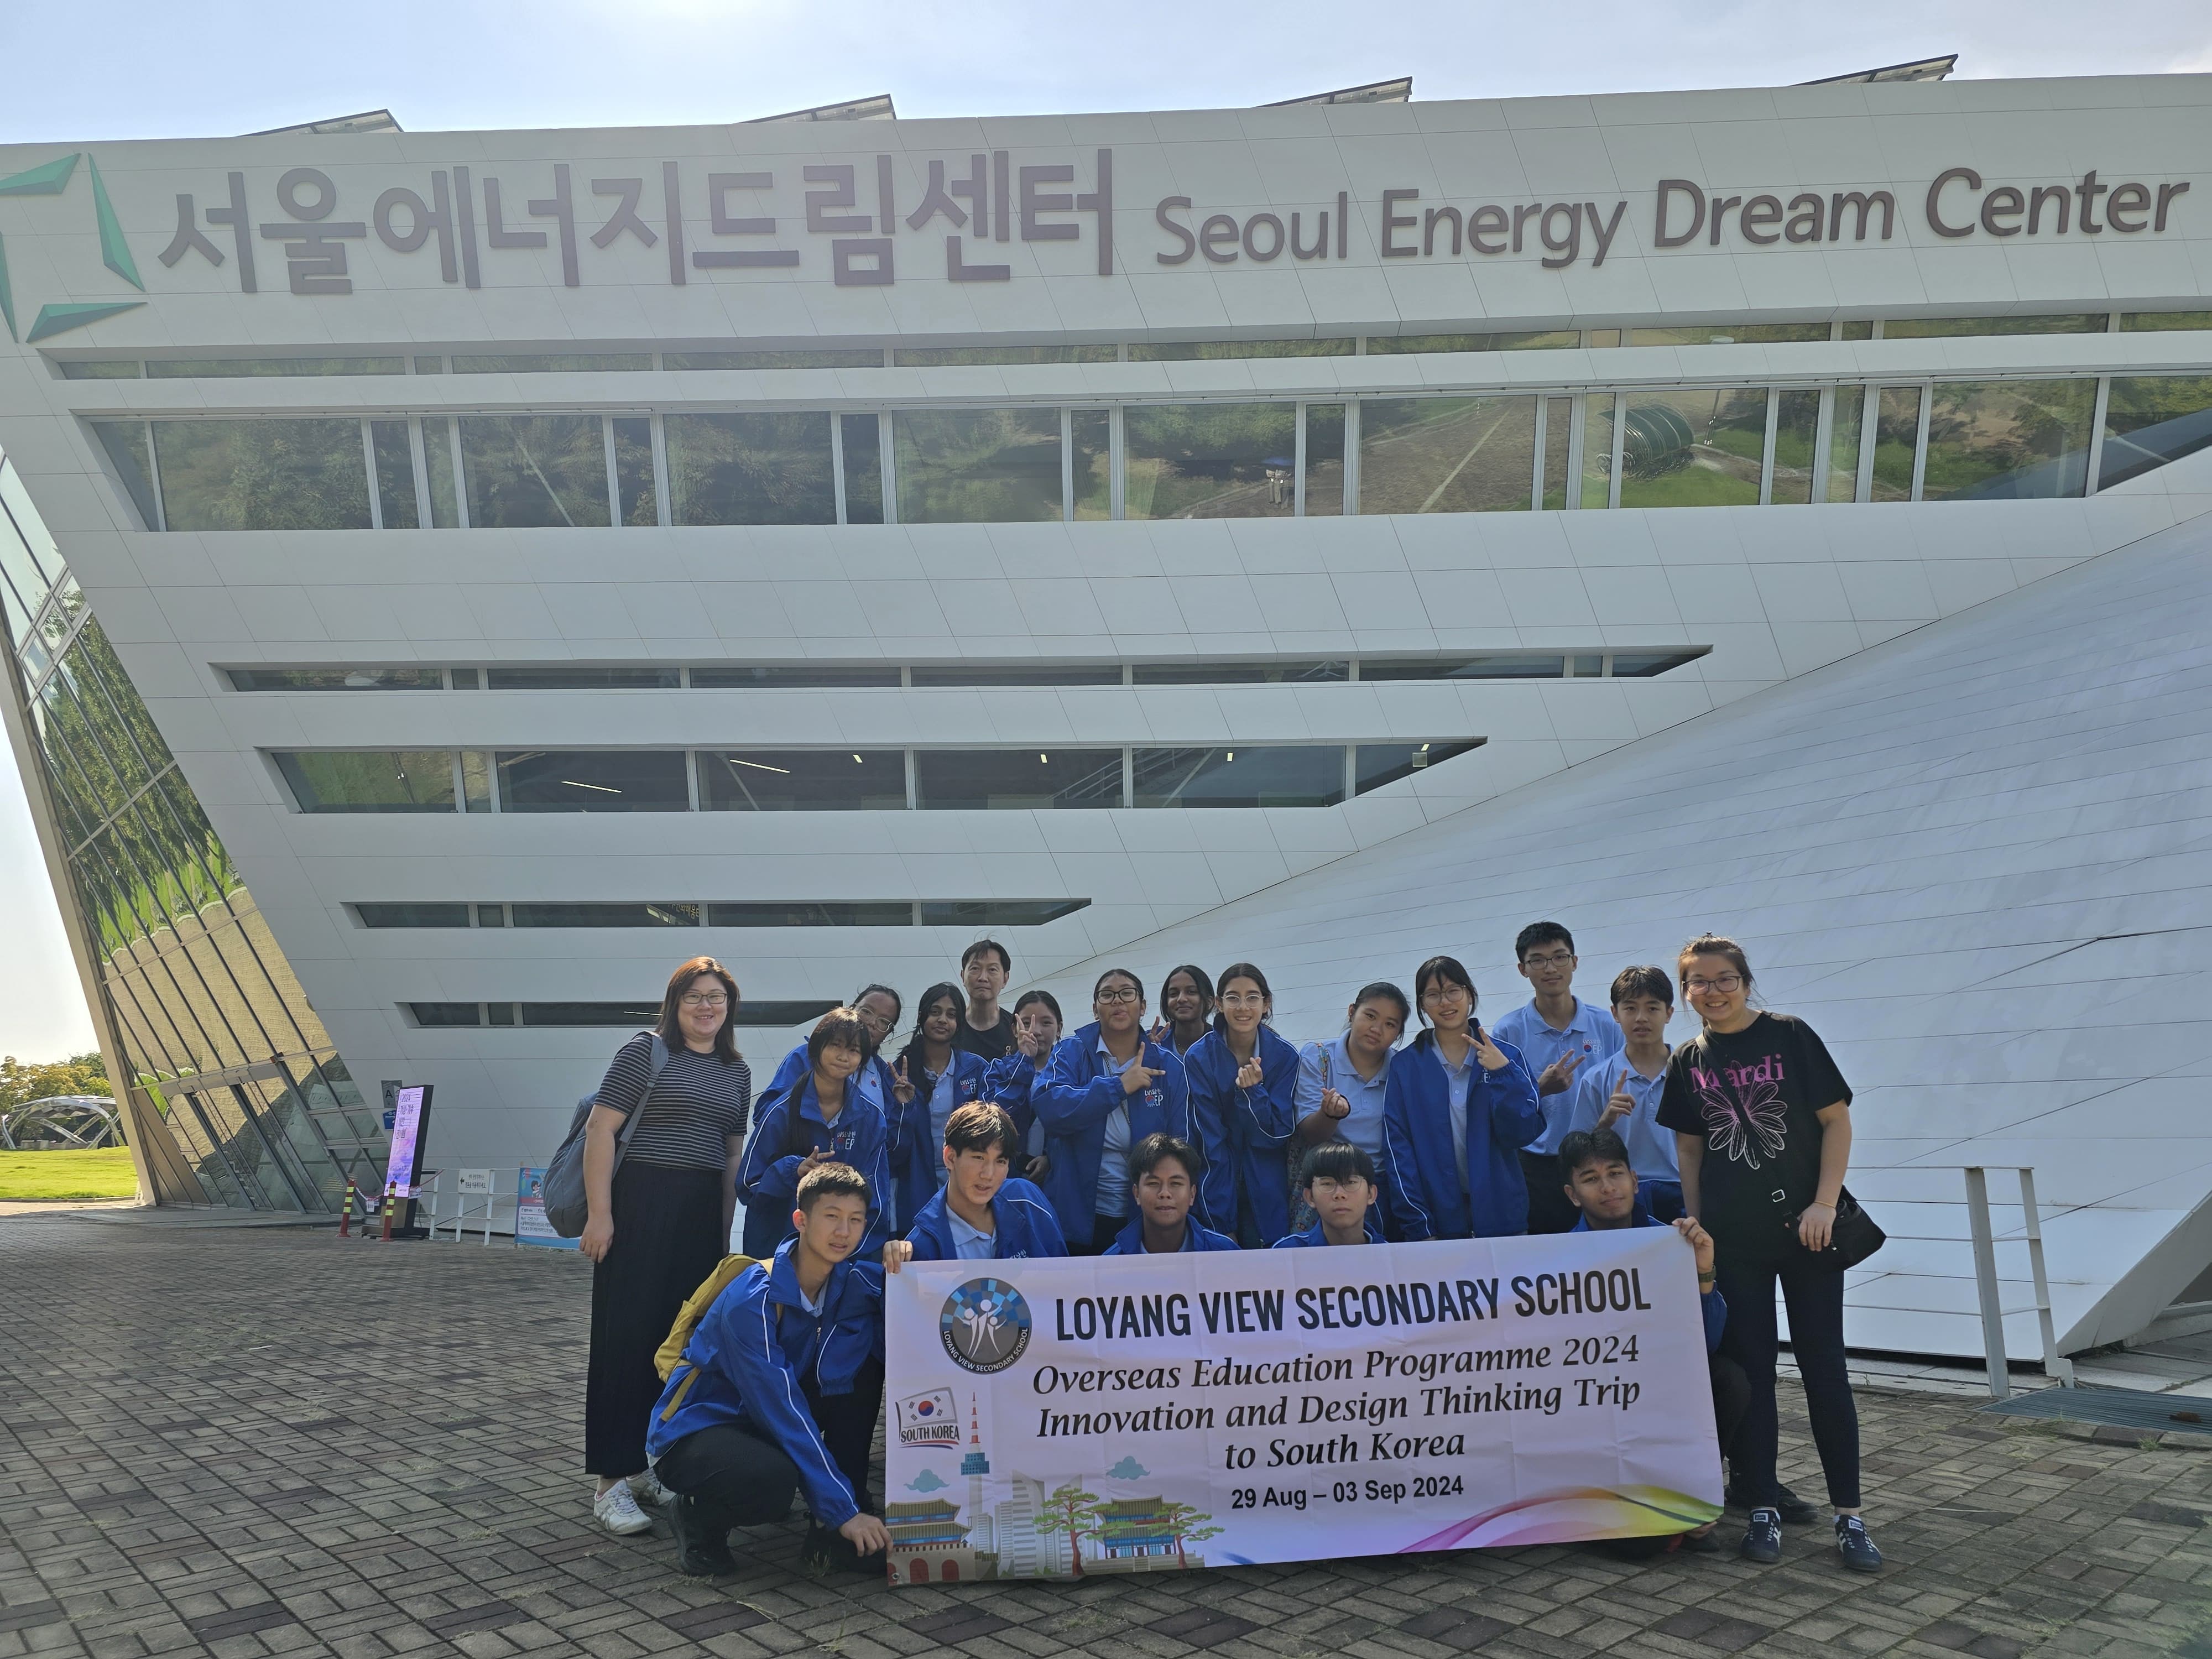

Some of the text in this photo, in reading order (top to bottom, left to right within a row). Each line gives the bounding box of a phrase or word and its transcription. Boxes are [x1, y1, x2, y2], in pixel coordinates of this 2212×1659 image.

[158, 148, 1114, 294] 서울에너지드림센터
[1156, 167, 2190, 272] Seoul Energy Dream Center
[385, 1089, 393, 1098] A
[1689, 1053, 1785, 1093] Mardi
[1056, 1268, 1651, 1342] LOYANG VIEW SECONDARY SCHOOL
[943, 1328, 1029, 1372] LOYANG VIEW SECONDARY SCHOOL
[1033, 1334, 1639, 1395] Overseas Education Programme 2024
[1036, 1376, 1640, 1437] Innovation and Design Thinking Trip
[900, 1425, 959, 1443] SOUTH KOREA
[1225, 1432, 1465, 1470] to South Korea
[1231, 1488, 1256, 1510] 29
[1262, 1486, 1307, 1511] Aug
[1333, 1481, 1358, 1503] 03
[1365, 1479, 1406, 1505] Sep
[1412, 1475, 1464, 1498] 2024
